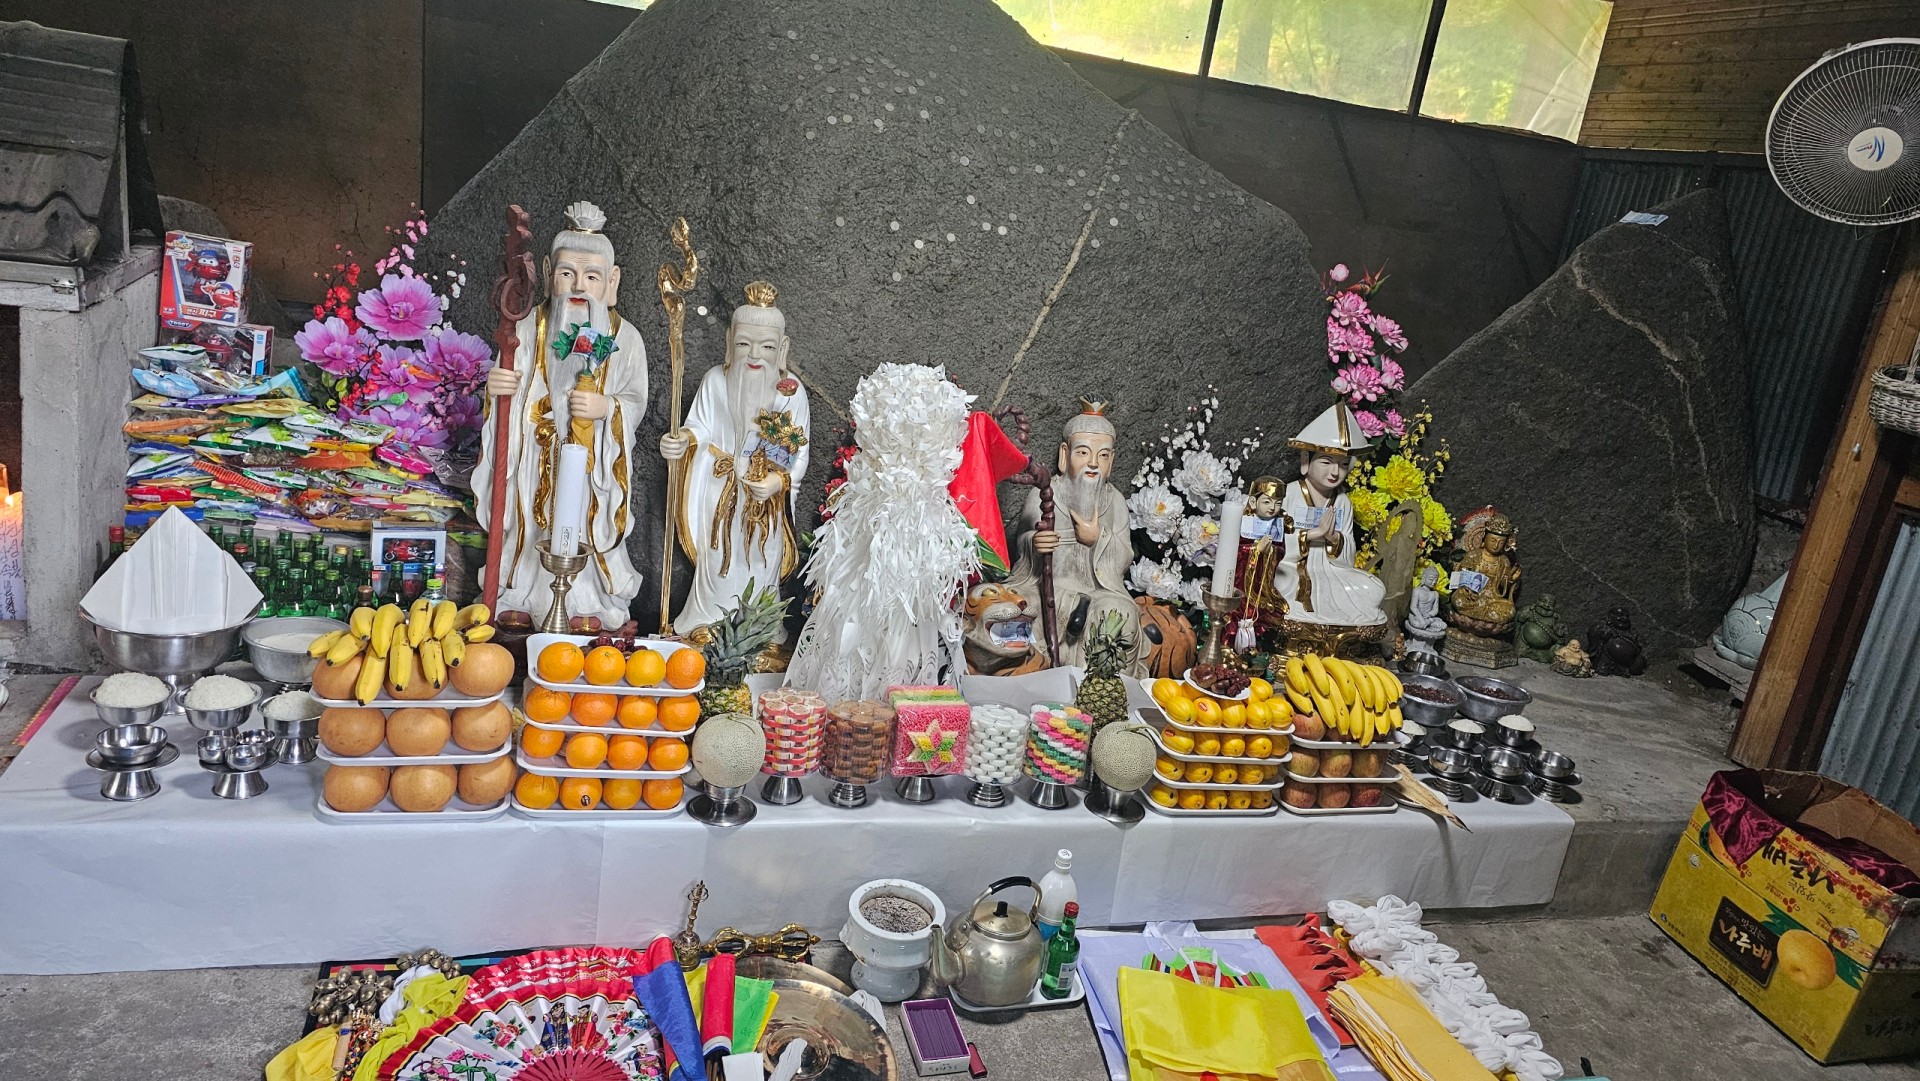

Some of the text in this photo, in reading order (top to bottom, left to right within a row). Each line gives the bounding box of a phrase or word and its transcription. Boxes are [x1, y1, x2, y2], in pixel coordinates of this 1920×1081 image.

[1761, 841, 1834, 894] 나주배
[1788, 879, 1816, 903] 맛있는
[1792, 904, 1801, 912] CJ
[1741, 919, 1766, 942] 맛있는
[1719, 919, 1773, 970] 나주배
